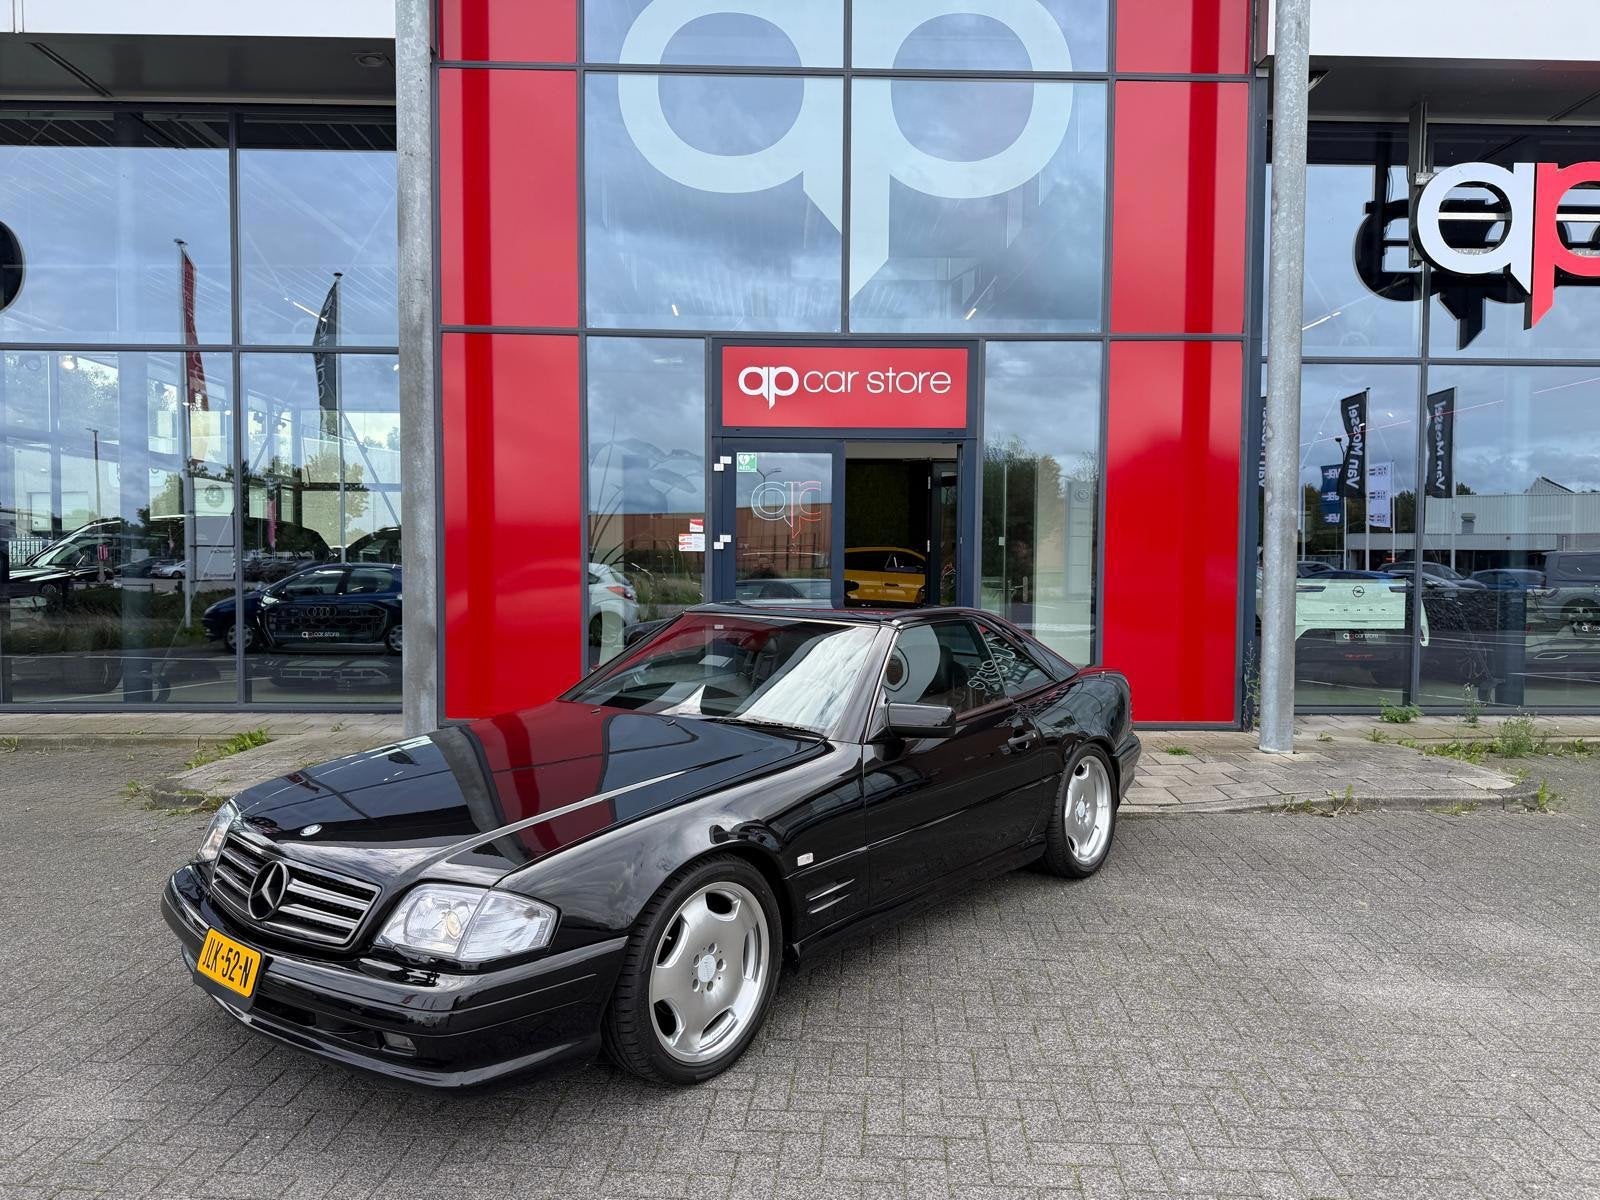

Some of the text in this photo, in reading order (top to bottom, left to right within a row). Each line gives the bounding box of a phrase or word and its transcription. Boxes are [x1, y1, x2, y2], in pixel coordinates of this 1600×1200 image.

[738, 366, 952, 410] ap car store
